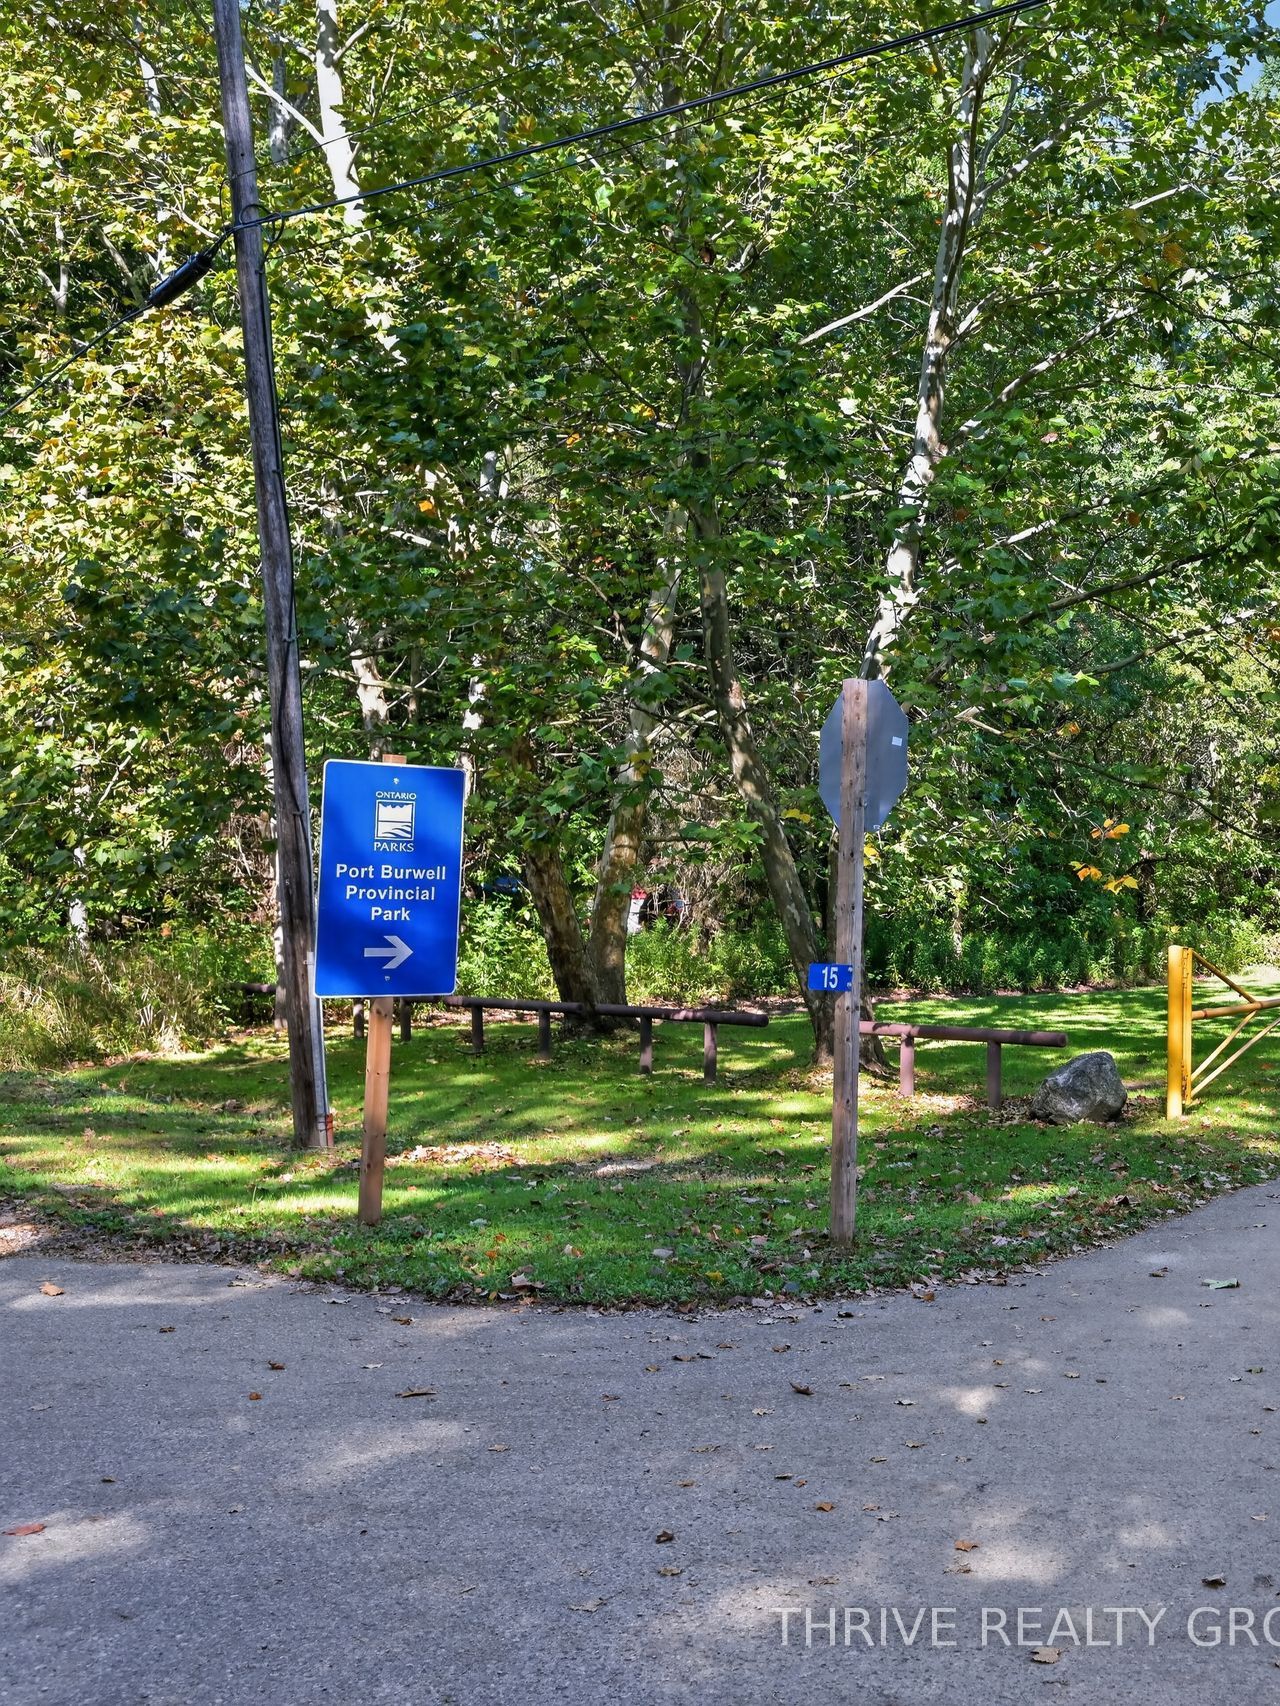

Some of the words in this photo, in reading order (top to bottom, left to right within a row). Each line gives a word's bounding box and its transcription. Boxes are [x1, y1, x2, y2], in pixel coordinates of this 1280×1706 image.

[375, 791, 417, 800] ONTARIO
[373, 842, 415, 852] PARKS
[336, 863, 375, 879] Port
[381, 864, 446, 880] Burwell
[346, 885, 435, 900] Provincial
[371, 907, 411, 921] Park
[821, 966, 839, 989] 15
